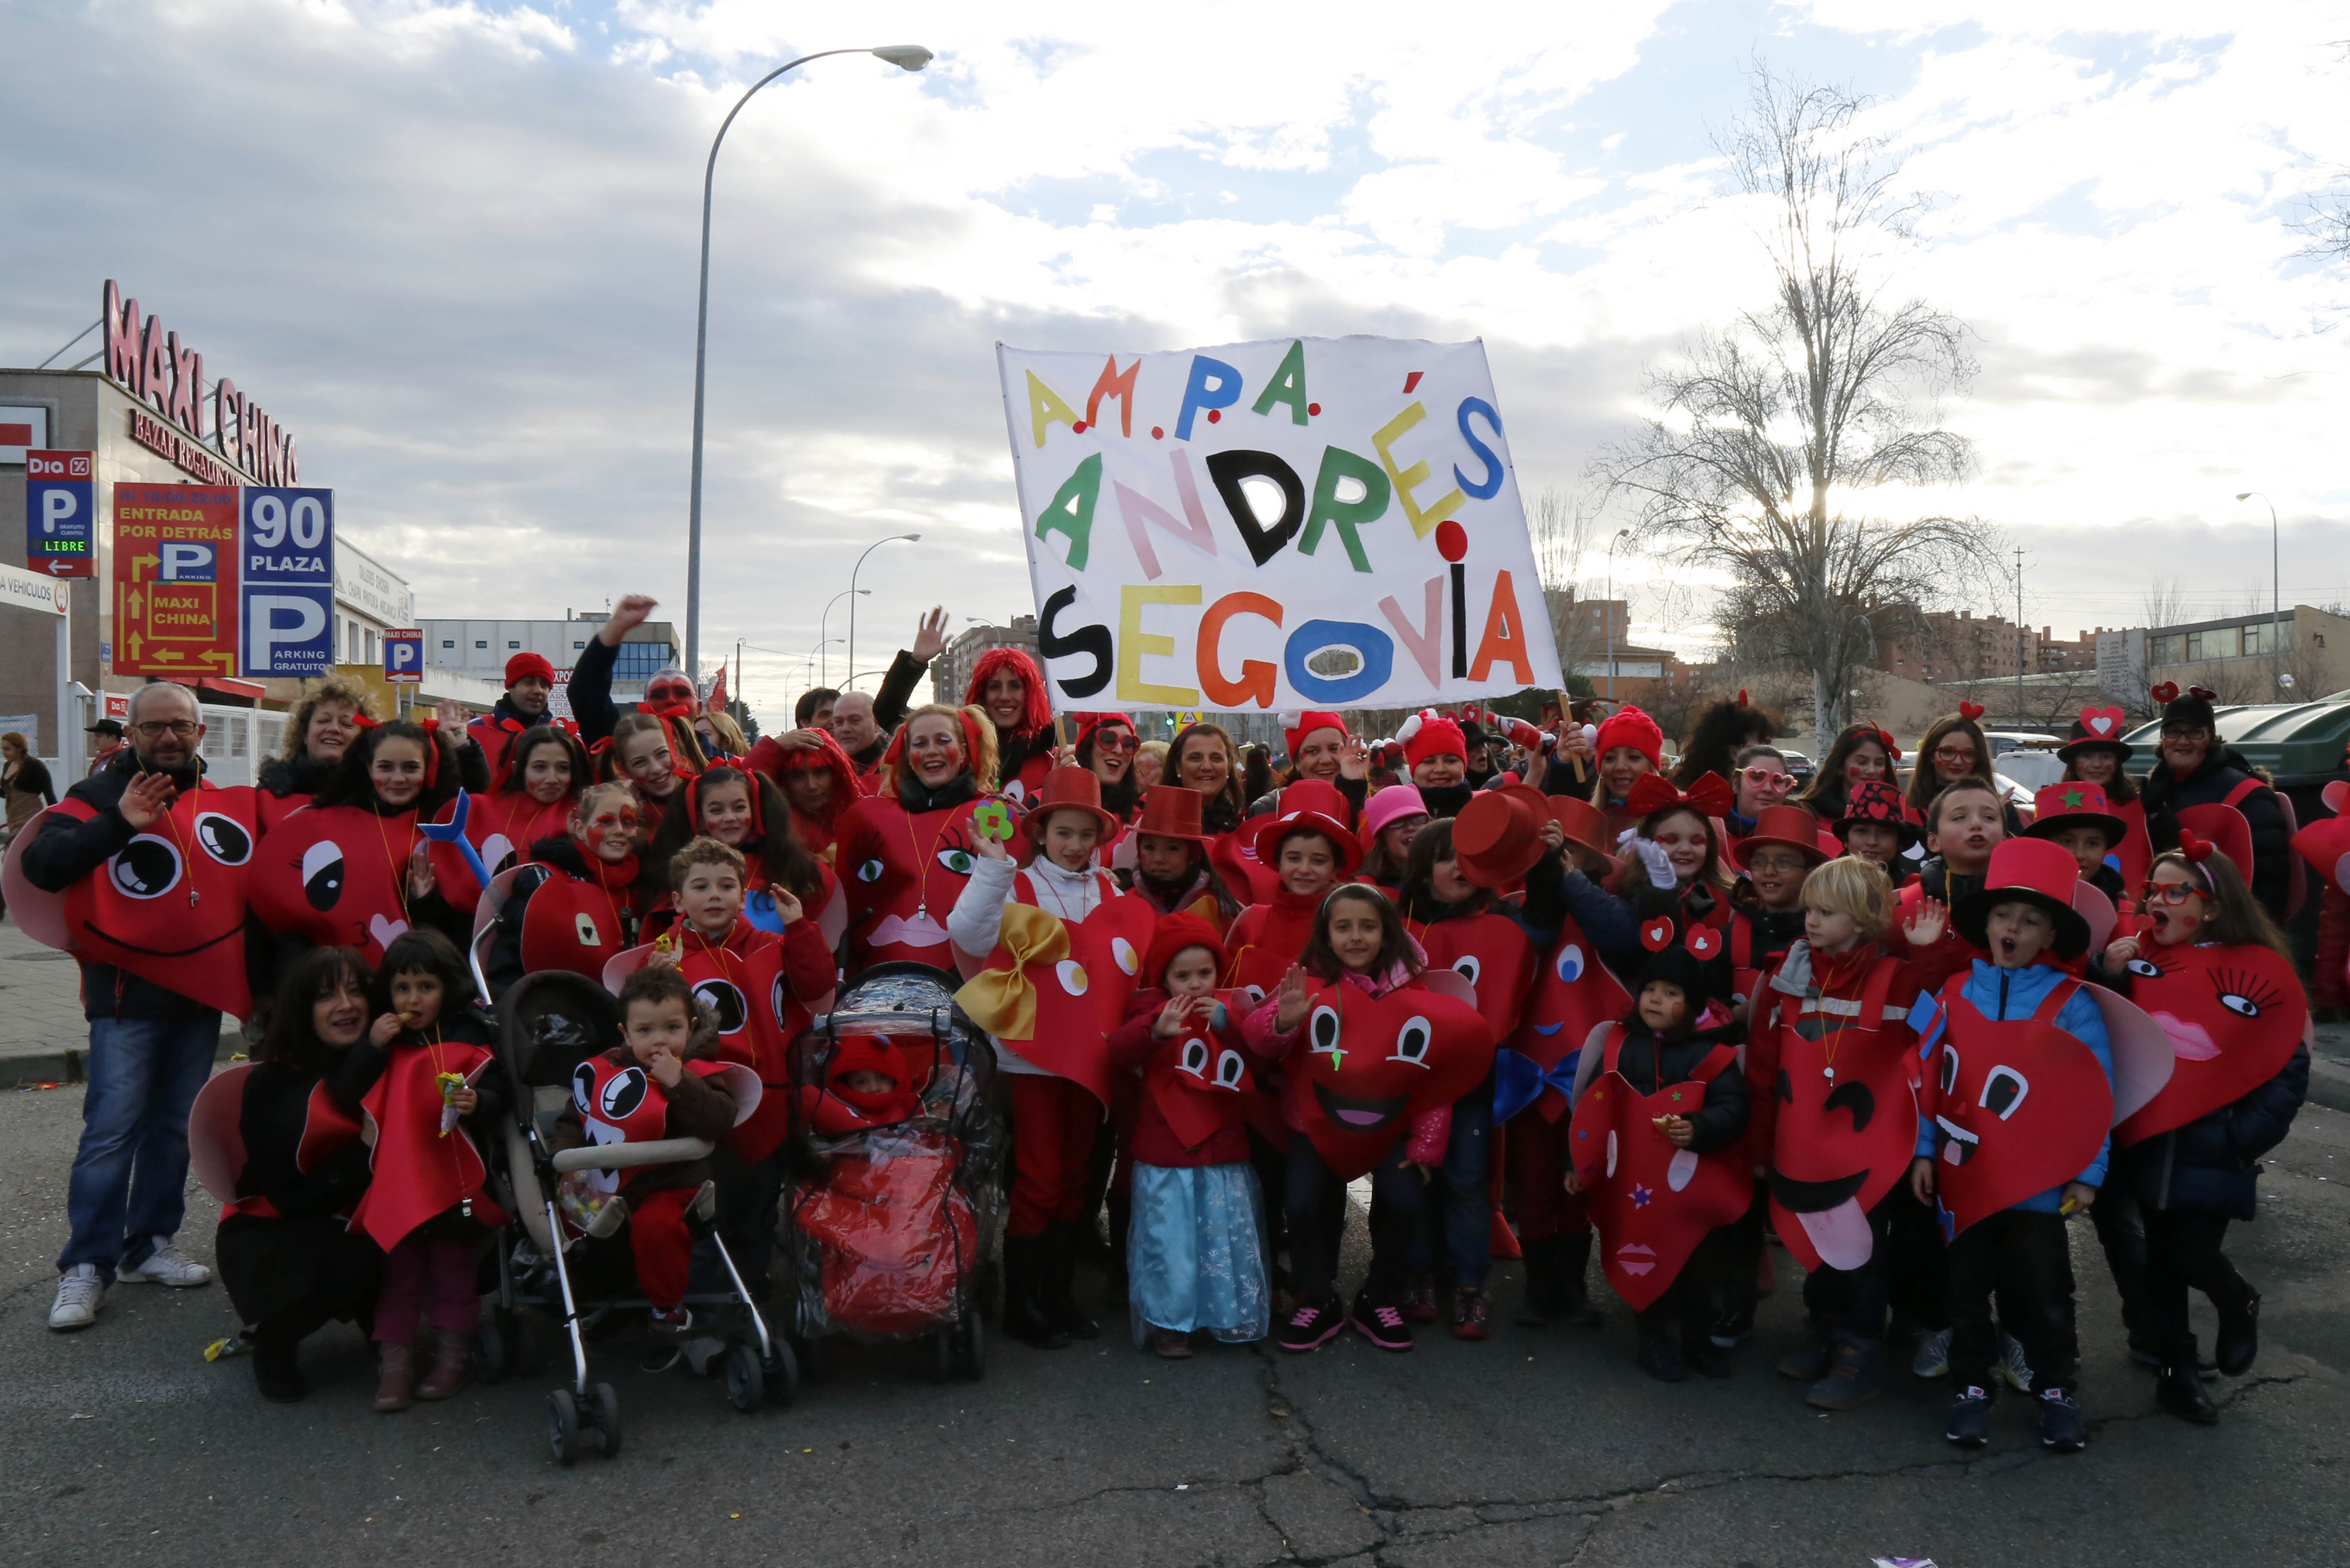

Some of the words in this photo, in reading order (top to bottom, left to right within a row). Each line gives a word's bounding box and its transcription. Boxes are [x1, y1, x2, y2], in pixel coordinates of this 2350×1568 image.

[103, 279, 203, 440] MAXI
[215, 378, 300, 486] CHINA
[130, 408, 175, 460] BAZAR
[174, 437, 224, 485] REGALOS
[1034, 371, 1504, 580] ANDRÉS
[120, 491, 136, 502] H:
[143, 492, 232, 504] 10:00-22:00
[43, 489, 77, 533] P
[119, 508, 205, 522] ENTRADA
[252, 495, 324, 549] 90
[120, 525, 157, 538] POR
[162, 525, 233, 540] DETRÁS
[45, 541, 85, 551] LIBRE
[251, 555, 326, 572] PLAZA
[8, 579, 51, 601] VEHICULOS
[348, 581, 362, 601] CHAPA
[362, 589, 378, 610] PINTURA
[154, 597, 199, 609] MAXI
[1038, 520, 1535, 708] SEGOVIA
[154, 613, 211, 625] CHINA
[394, 644, 414, 670] P
